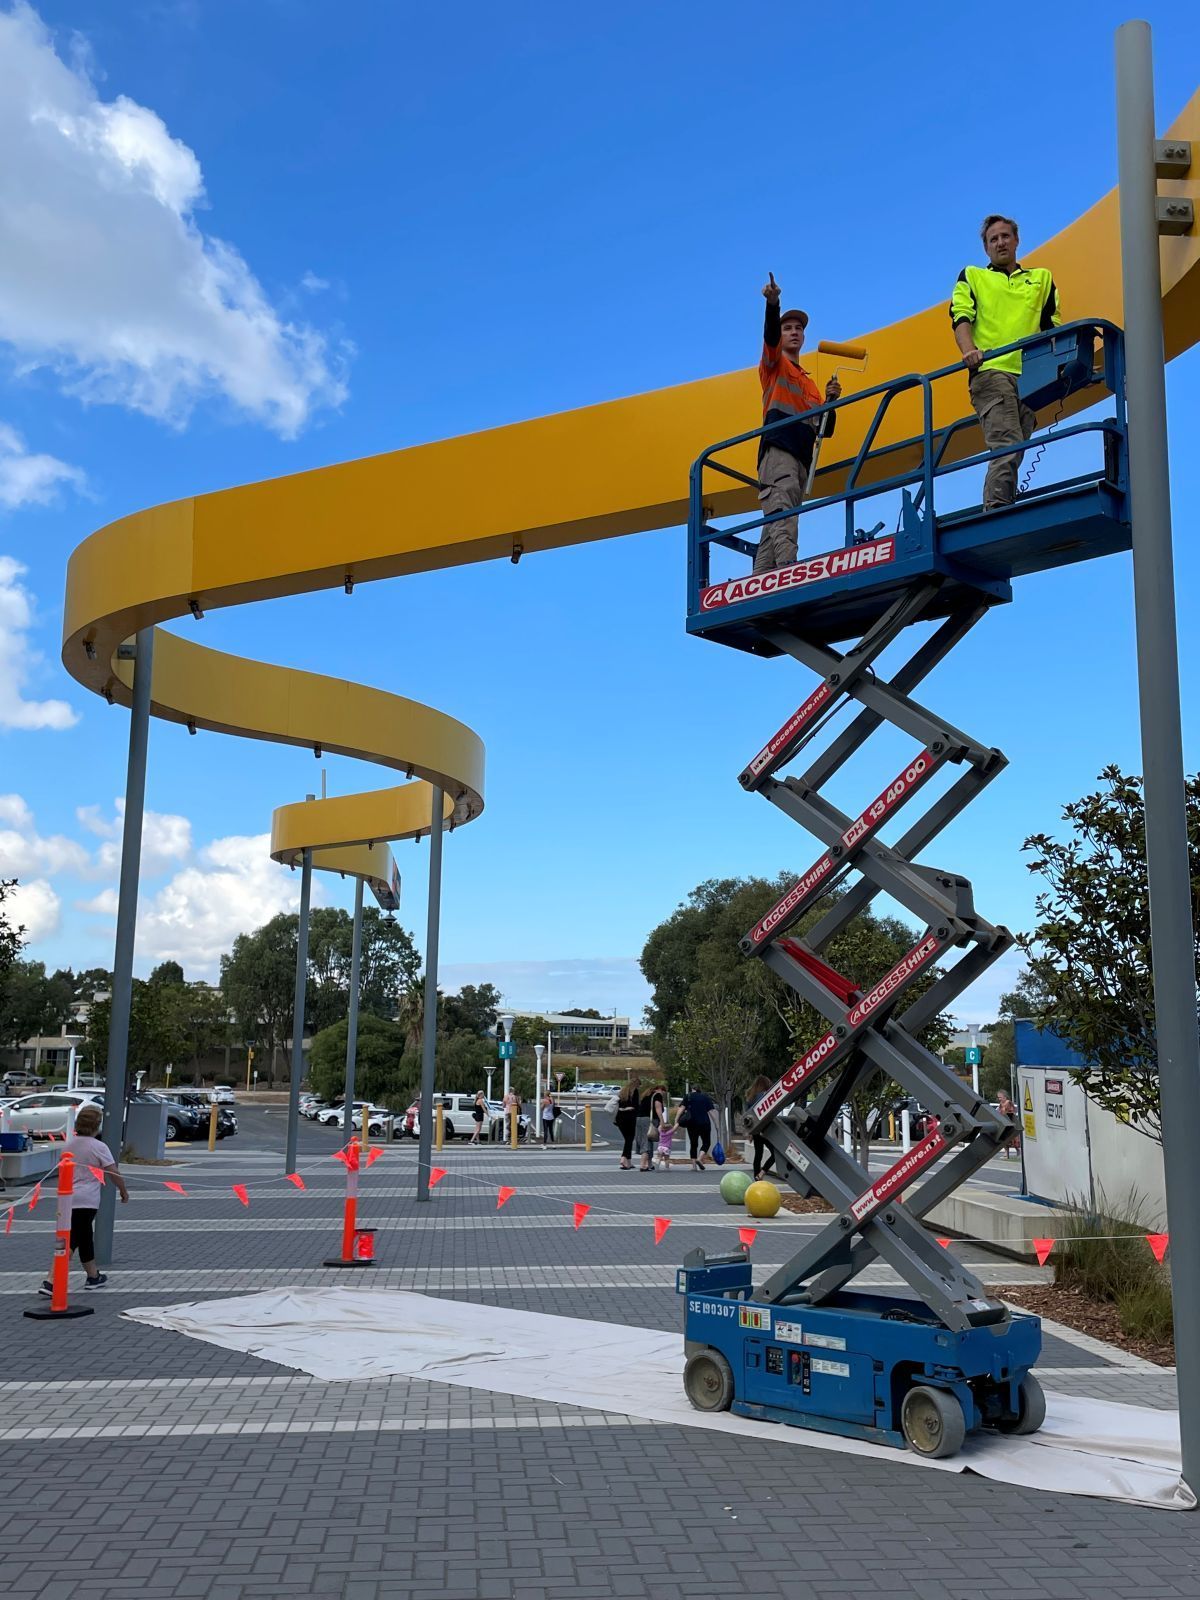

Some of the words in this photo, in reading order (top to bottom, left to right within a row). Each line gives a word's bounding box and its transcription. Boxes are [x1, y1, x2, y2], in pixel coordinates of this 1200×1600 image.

[729, 560, 825, 600] ACCESS
[830, 541, 892, 574] HIRE
[869, 799, 886, 820] 13
[765, 884, 805, 929] ACCESS
[805, 857, 831, 887] HIRE
[863, 965, 907, 1013] ACCESS
[907, 937, 936, 968] HIRE
[756, 1086, 783, 1117] HIRE
[791, 1065, 805, 1082] 13
[805, 1035, 835, 1070] 4000
[855, 1195, 874, 1214] www
[689, 1300, 701, 1313] SE
